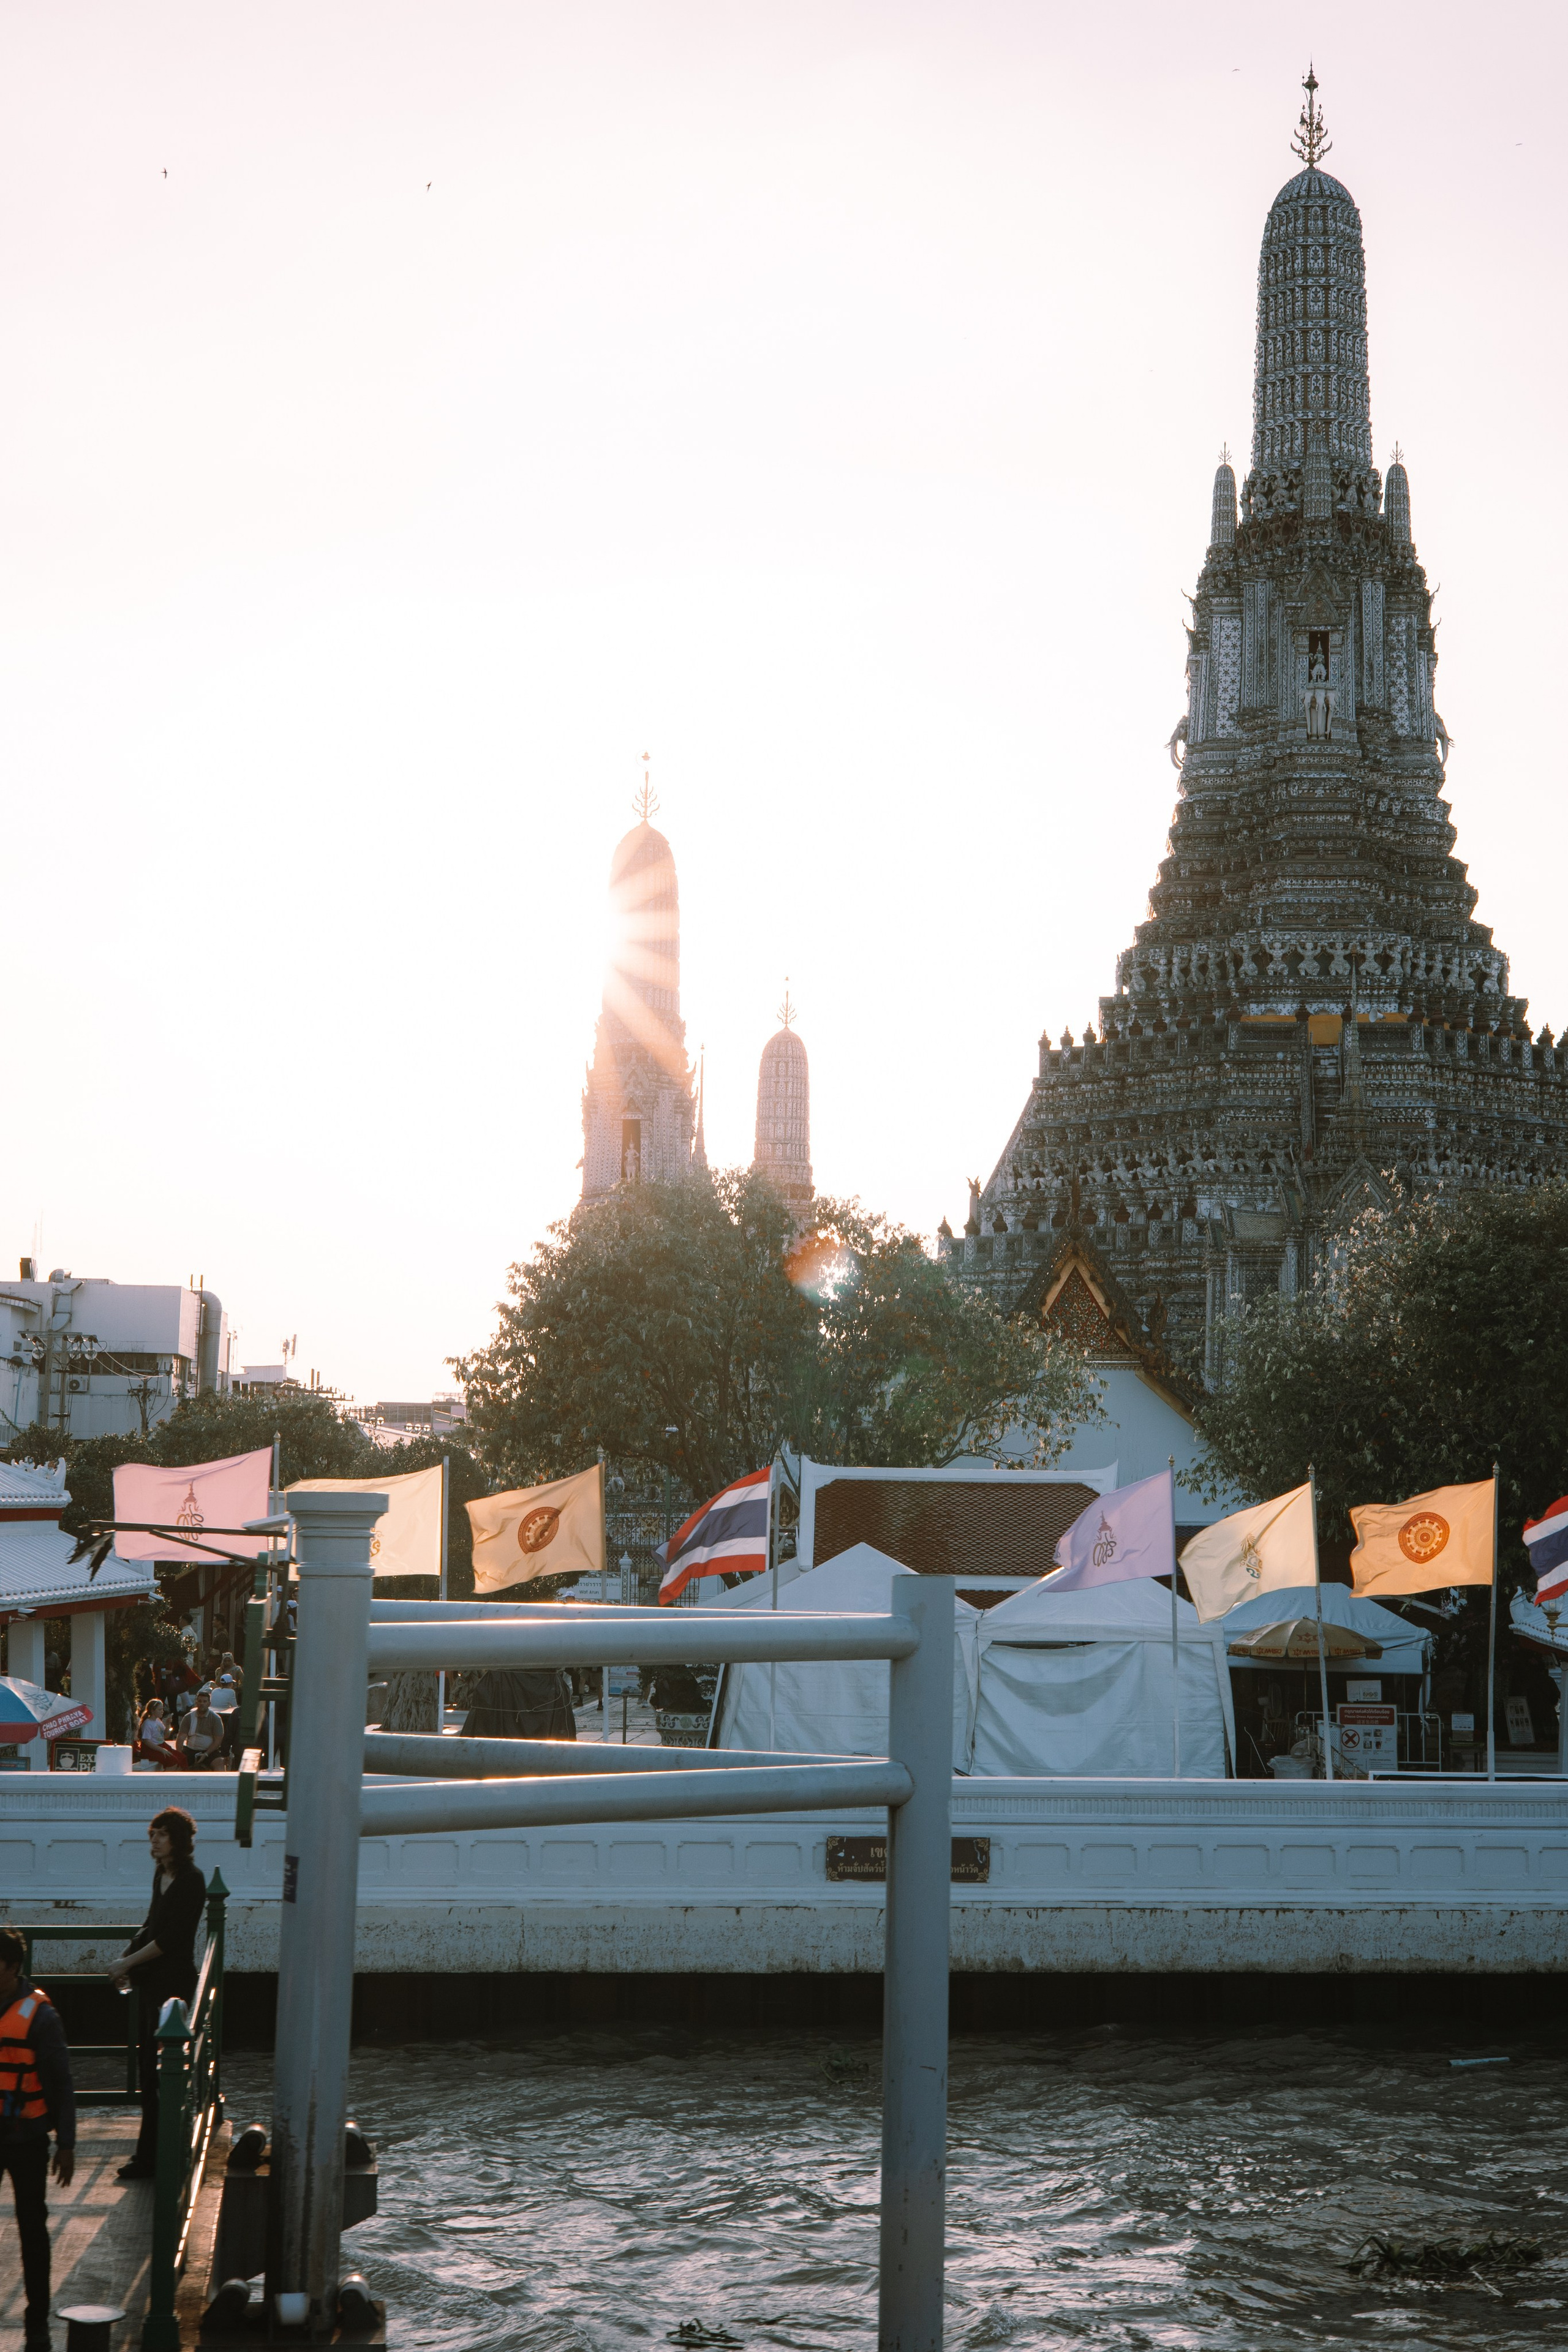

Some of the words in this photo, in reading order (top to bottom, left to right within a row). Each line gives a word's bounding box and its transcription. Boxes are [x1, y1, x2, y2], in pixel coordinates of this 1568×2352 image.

[42, 1720, 57, 1731] CHAO
[58, 1710, 85, 1725] PHRAYA
[43, 1724, 69, 1739] TOURIST
[70, 1715, 88, 1728] BOAT
